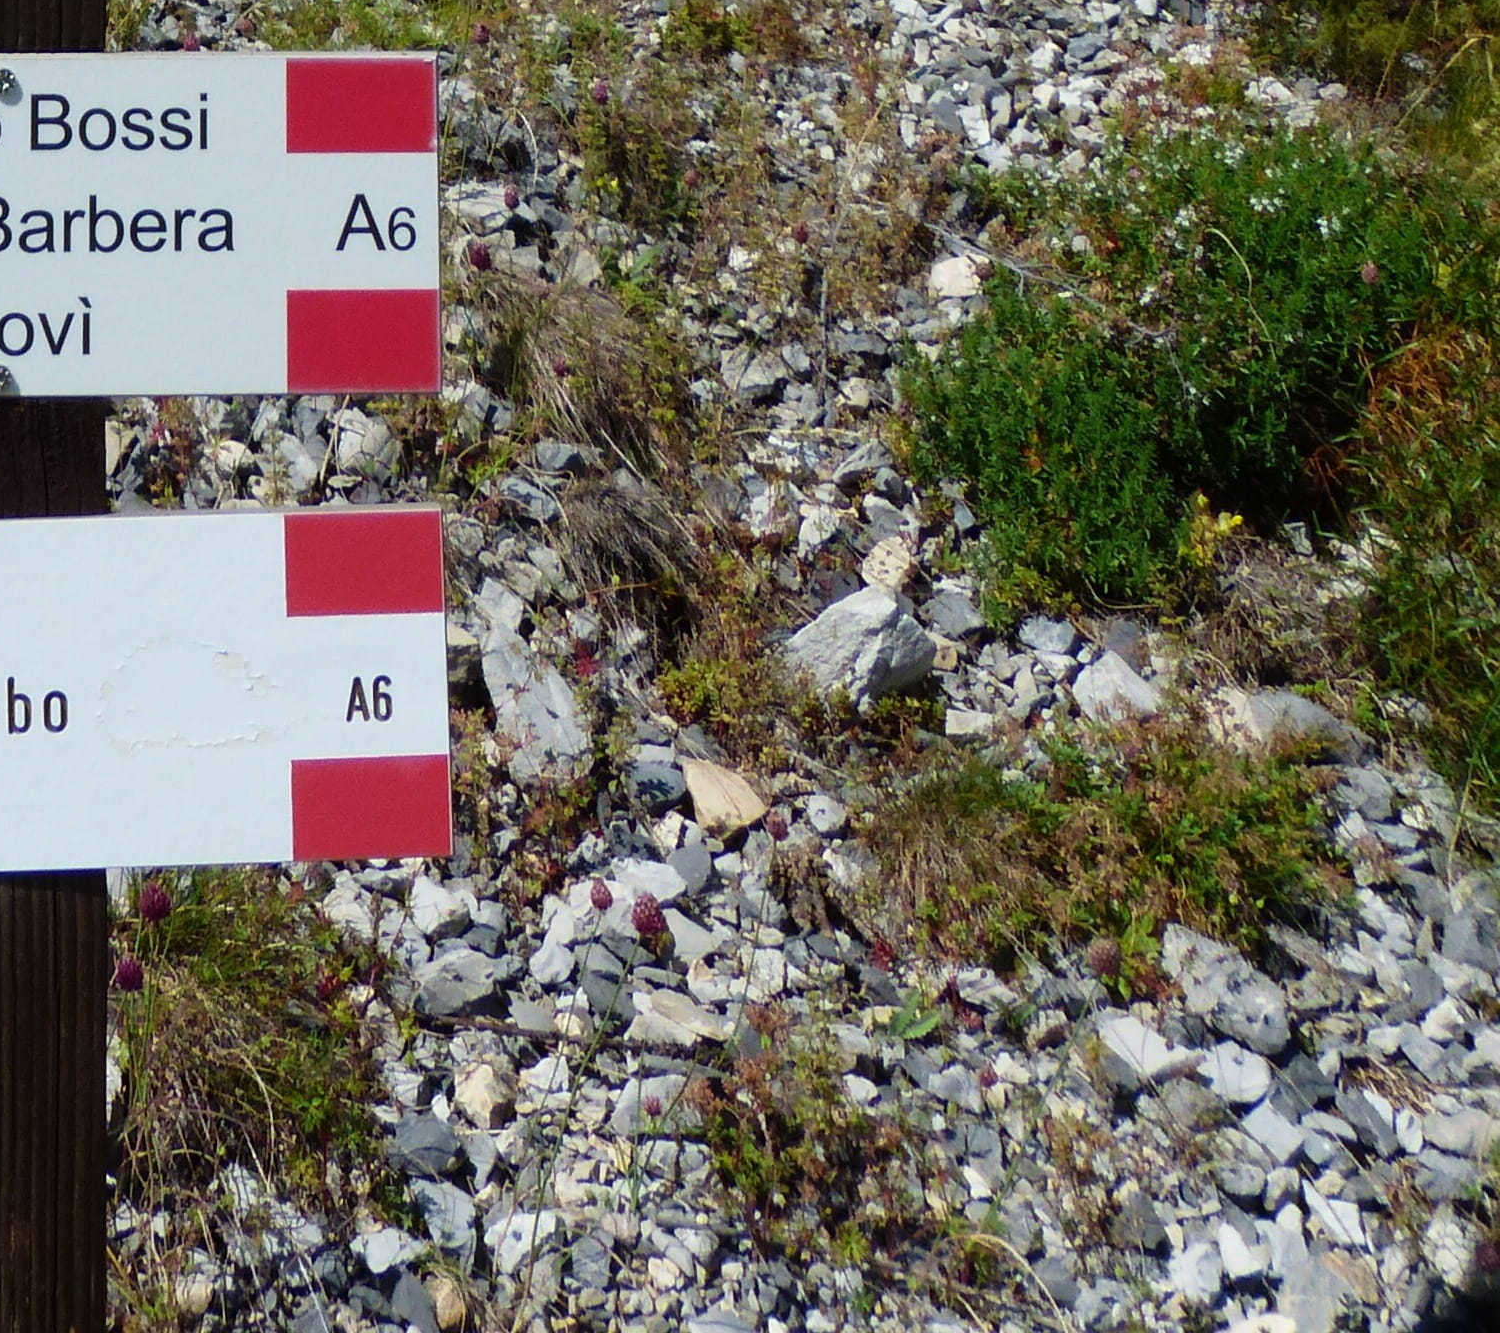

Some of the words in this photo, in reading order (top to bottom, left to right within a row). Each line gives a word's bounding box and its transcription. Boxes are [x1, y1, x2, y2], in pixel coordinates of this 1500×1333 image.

[30, 92, 208, 152] Bossi
[335, 193, 417, 252] A6
[346, 674, 393, 723] A6
